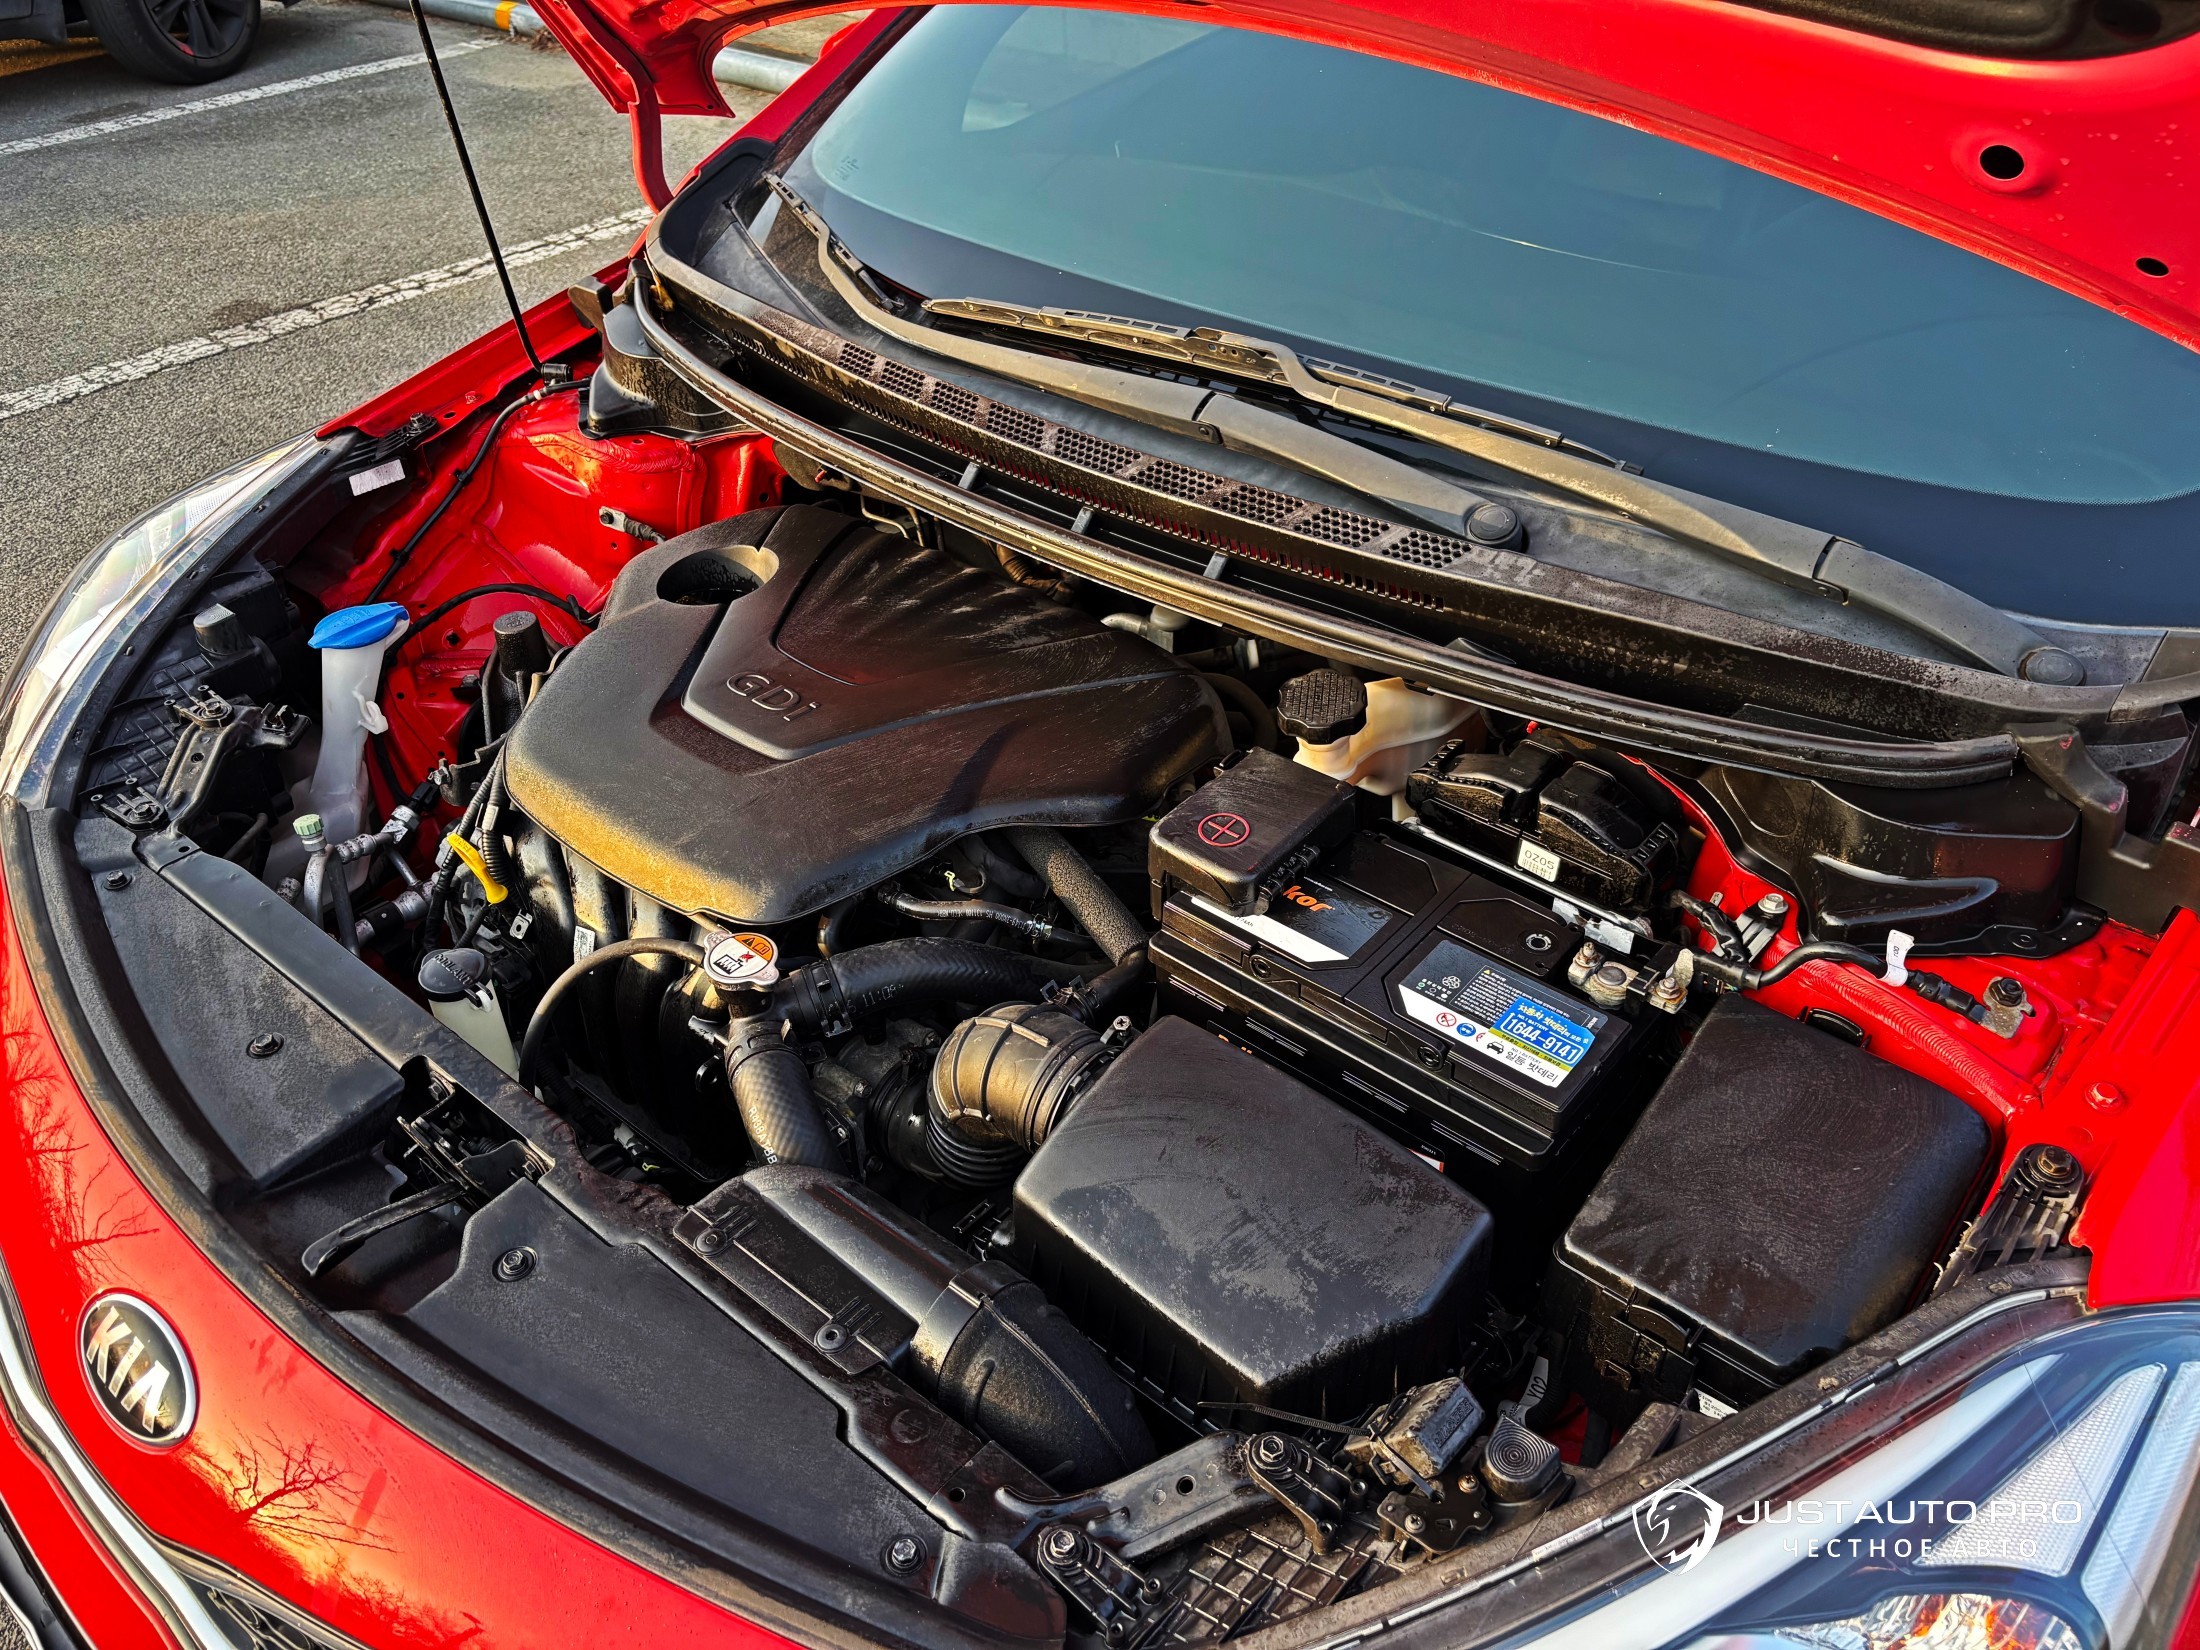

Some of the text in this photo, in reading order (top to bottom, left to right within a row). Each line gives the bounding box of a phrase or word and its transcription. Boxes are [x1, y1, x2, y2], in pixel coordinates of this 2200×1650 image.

[1507, 1018, 1578, 1061] 1644-9141
[1527, 1061, 1558, 1083] 밧데리
[86, 1305, 170, 1434] KIA
